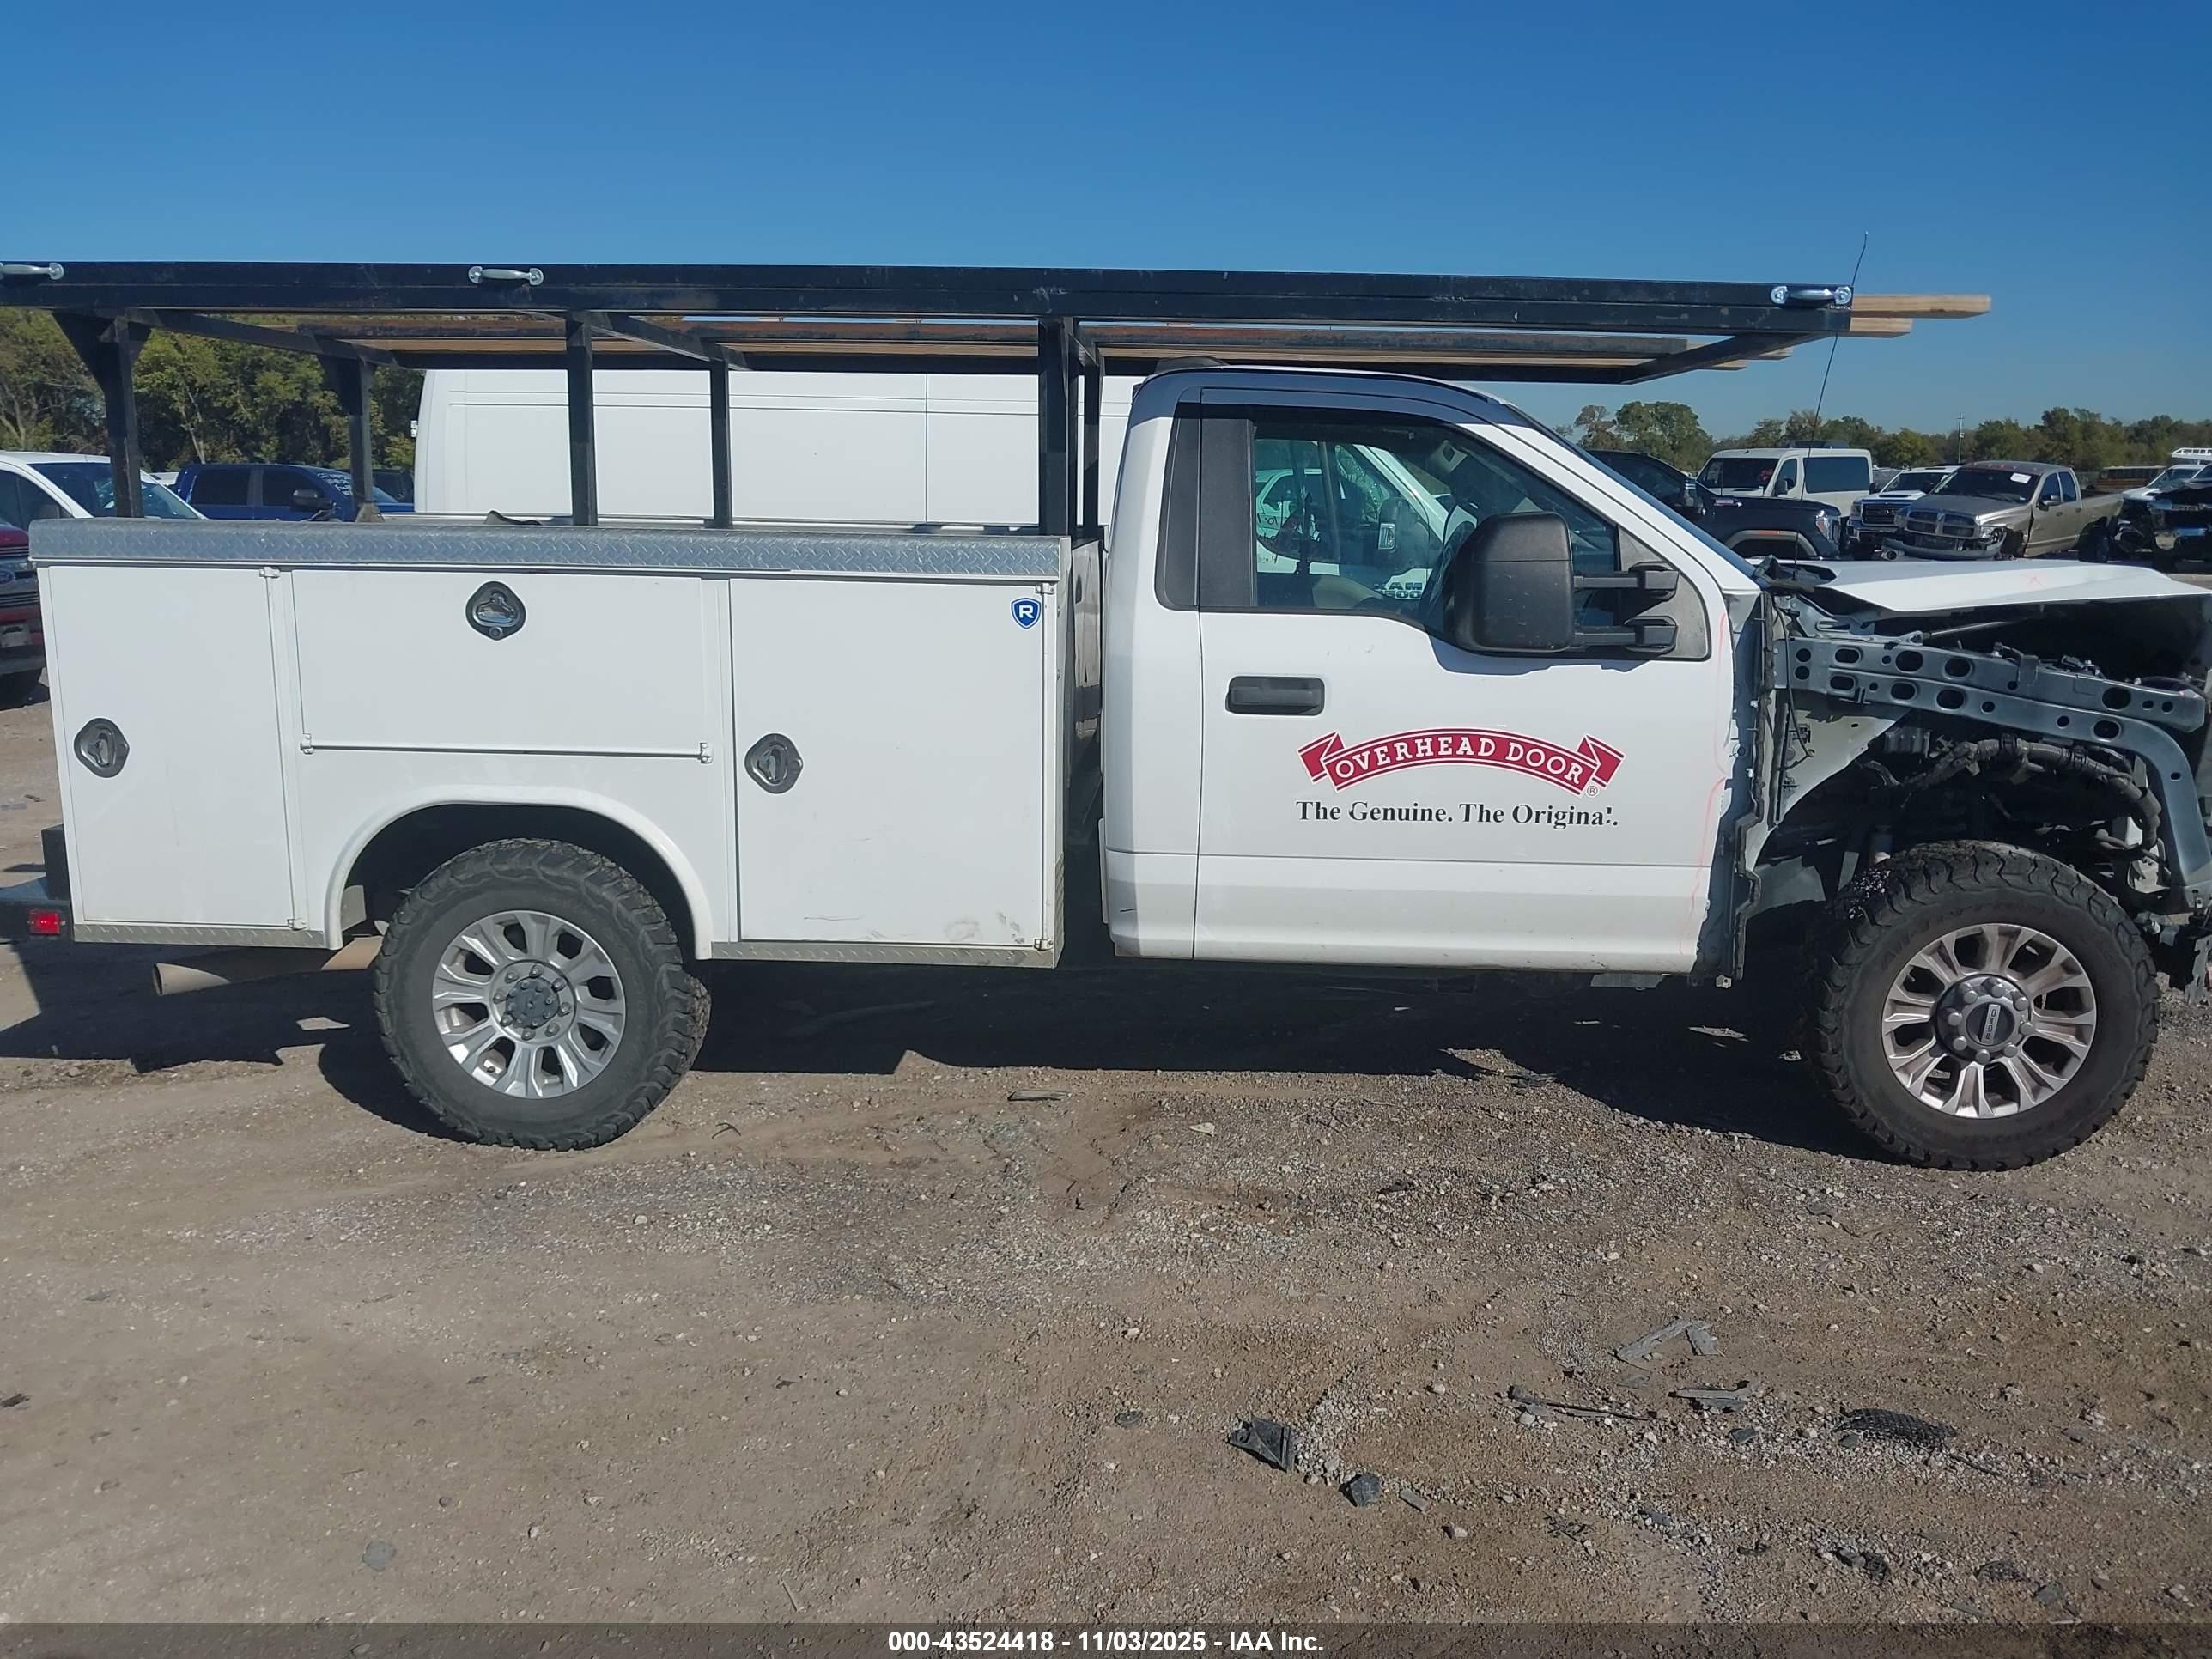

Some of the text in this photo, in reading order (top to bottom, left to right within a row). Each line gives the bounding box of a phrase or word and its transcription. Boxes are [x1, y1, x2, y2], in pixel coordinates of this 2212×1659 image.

[1378, 590, 1423, 599] 500
[1018, 604, 1035, 619] R
[1334, 736, 1583, 785] OVERHEAD DOOR
[1296, 801, 1341, 820] The
[1348, 801, 1454, 823] Genuine.
[1459, 802, 1504, 823] The
[1984, 1007, 1998, 1041] FORD
